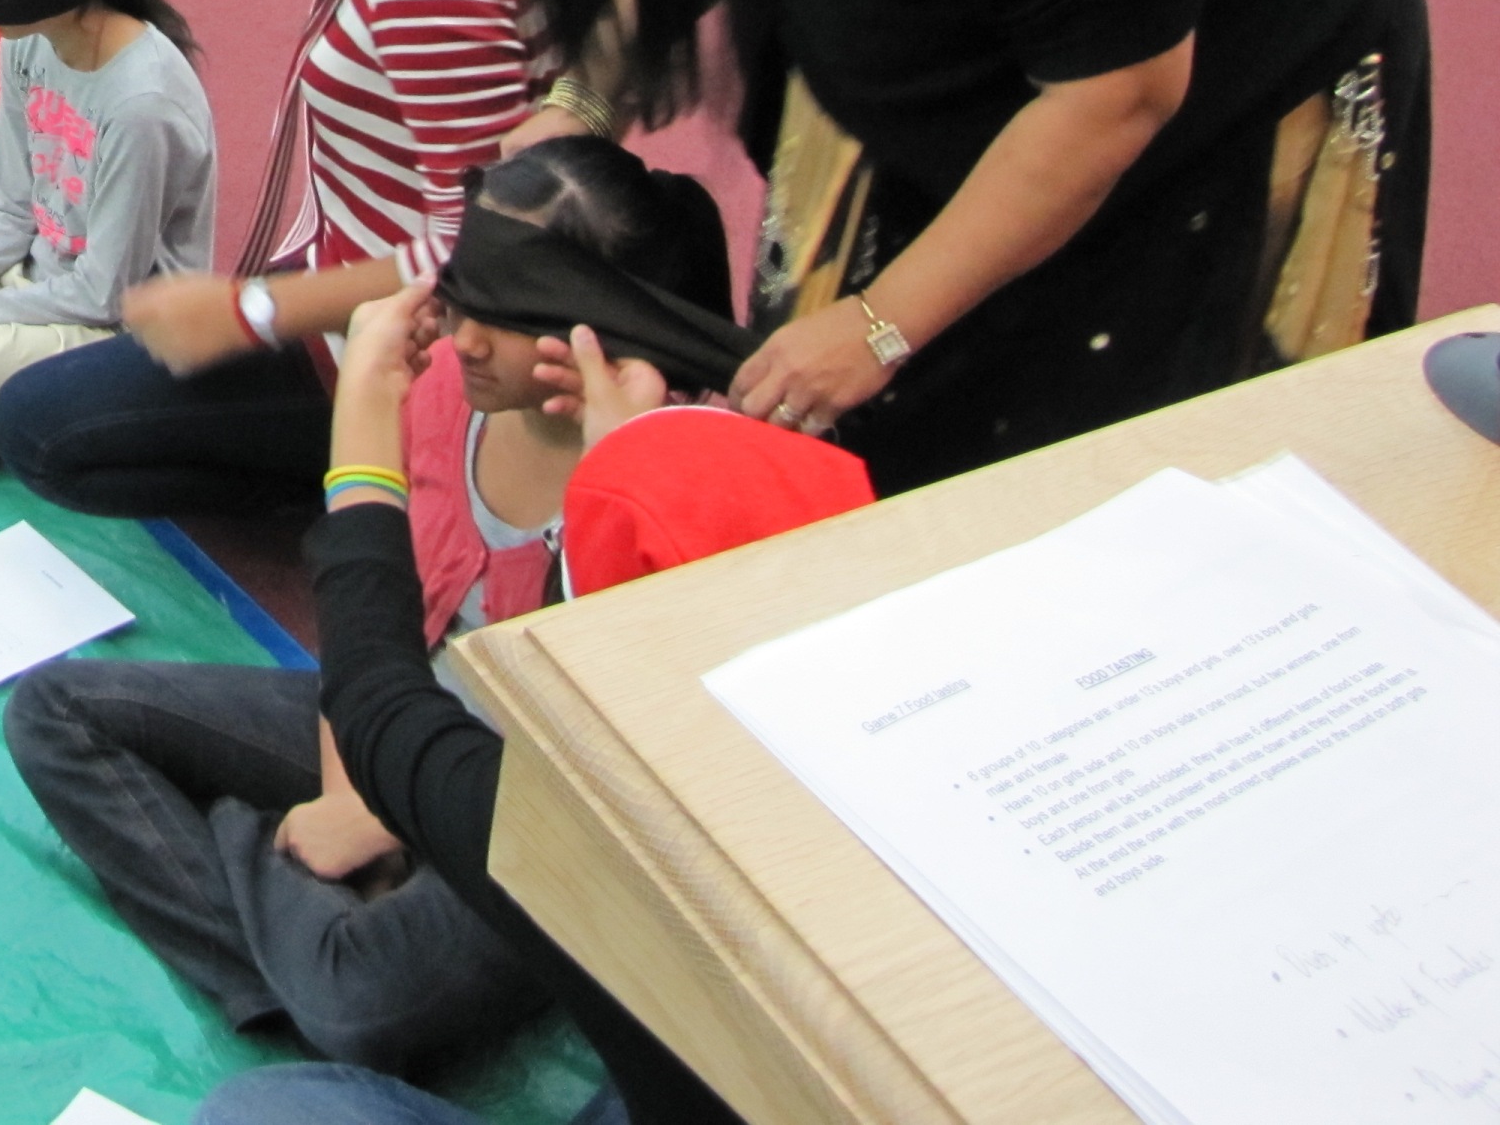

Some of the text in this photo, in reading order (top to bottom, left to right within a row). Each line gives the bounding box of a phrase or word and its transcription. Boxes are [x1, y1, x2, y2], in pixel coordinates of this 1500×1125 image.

[861, 711, 898, 735] Game
[904, 693, 934, 713] Food
[933, 677, 970, 701] tasting
[978, 755, 1016, 779] groups
[1043, 717, 1094, 745] categories
[1114, 693, 1141, 710] under
[1158, 673, 1185, 688] boys
[1182, 663, 1203, 677] and
[1223, 643, 1244, 657] over
[1260, 625, 1282, 637] boy
[1279, 612, 1299, 628] and
[1002, 794, 1034, 813] Have
[1062, 769, 1085, 787] girls
[1083, 759, 1107, 774] side
[1105, 747, 1127, 763] and
[1150, 722, 1178, 738] boys
[1176, 712, 1198, 726] side
[1206, 698, 1226, 712] one
[1250, 675, 1271, 688] but
[1266, 668, 1287, 680] two
[1321, 638, 1341, 651] one
[1336, 626, 1361, 641] from
[1075, 647, 1155, 690] FOOD TASTING
[986, 752, 1069, 797] male and female
[1019, 769, 1135, 829] boys and one from girls
[1037, 827, 1069, 846] Each
[1067, 810, 1105, 834] person
[1103, 800, 1122, 814] will
[1117, 793, 1136, 805] be
[1190, 751, 1217, 766] they
[1213, 742, 1231, 755] will
[1227, 732, 1254, 747] have
[1259, 708, 1299, 732] different
[1295, 696, 1323, 713] items
[1327, 678, 1353, 694] food
[1054, 839, 1095, 863] Beside
[1092, 826, 1122, 844] them
[1119, 814, 1140, 830] will
[1134, 809, 1154, 821] be
[1161, 780, 1206, 808] volunteer
[1204, 769, 1228, 784] who
[1226, 759, 1244, 773] will
[1241, 750, 1265, 764] note
[1262, 738, 1289, 754] down
[1288, 725, 1312, 741] what
[1307, 715, 1333, 730] they
[1327, 702, 1354, 719] think
[1349, 695, 1369, 706] the
[1364, 682, 1390, 698] food
[1385, 673, 1407, 686] item
[1074, 866, 1092, 880] At
[1087, 858, 1109, 872] the
[1107, 845, 1130, 862] end
[1125, 838, 1147, 852] the
[1145, 827, 1167, 842] one
[1166, 816, 1188, 831] with
[1184, 806, 1206, 820] the
[1203, 791, 1231, 810] most
[1228, 774, 1264, 796] correct
[1260, 756, 1301, 781] guesses
[1298, 745, 1322, 760] wins
[1316, 737, 1334, 749] for
[1330, 729, 1350, 741] the
[1347, 713, 1376, 733] round
[1385, 696, 1409, 712] both
[1406, 686, 1427, 702] girls
[1094, 878, 1118, 897] and
[1112, 866, 1143, 885] boys
